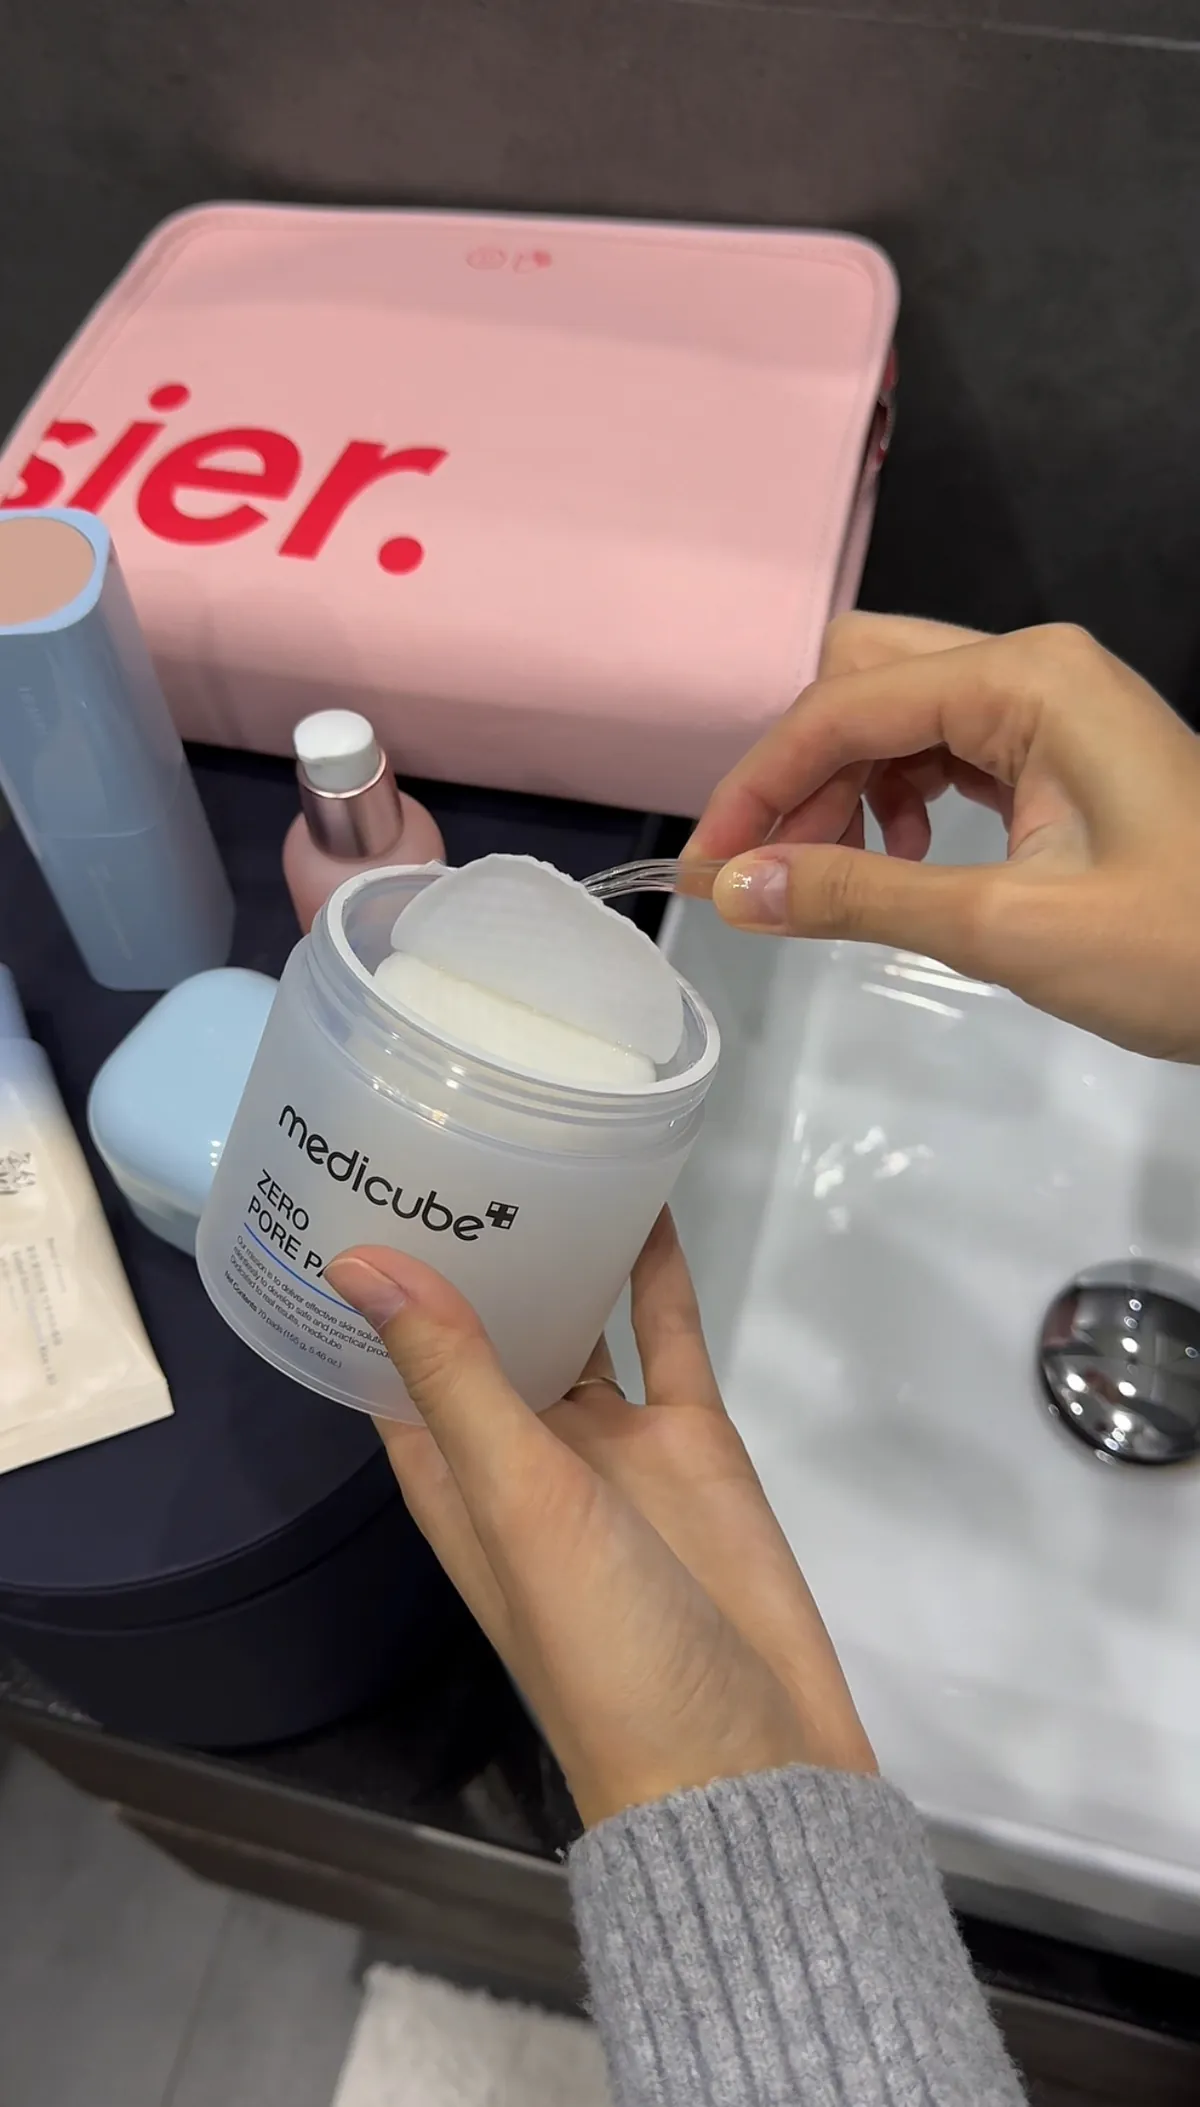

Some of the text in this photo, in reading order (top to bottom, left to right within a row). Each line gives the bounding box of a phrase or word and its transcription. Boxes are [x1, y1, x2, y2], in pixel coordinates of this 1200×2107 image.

[1, 381, 449, 576] sier.
[257, 1168, 310, 1231] ZERO
[278, 1104, 485, 1242] medicube
[247, 1195, 302, 1261] PORE
[267, 1284, 295, 1311] develop
[295, 1306, 313, 1322] safe
[312, 1318, 330, 1332] and
[329, 1327, 368, 1351] practical
[281, 1283, 305, 1304] deliver
[305, 1301, 338, 1325] effective
[338, 1320, 356, 1334] skin
